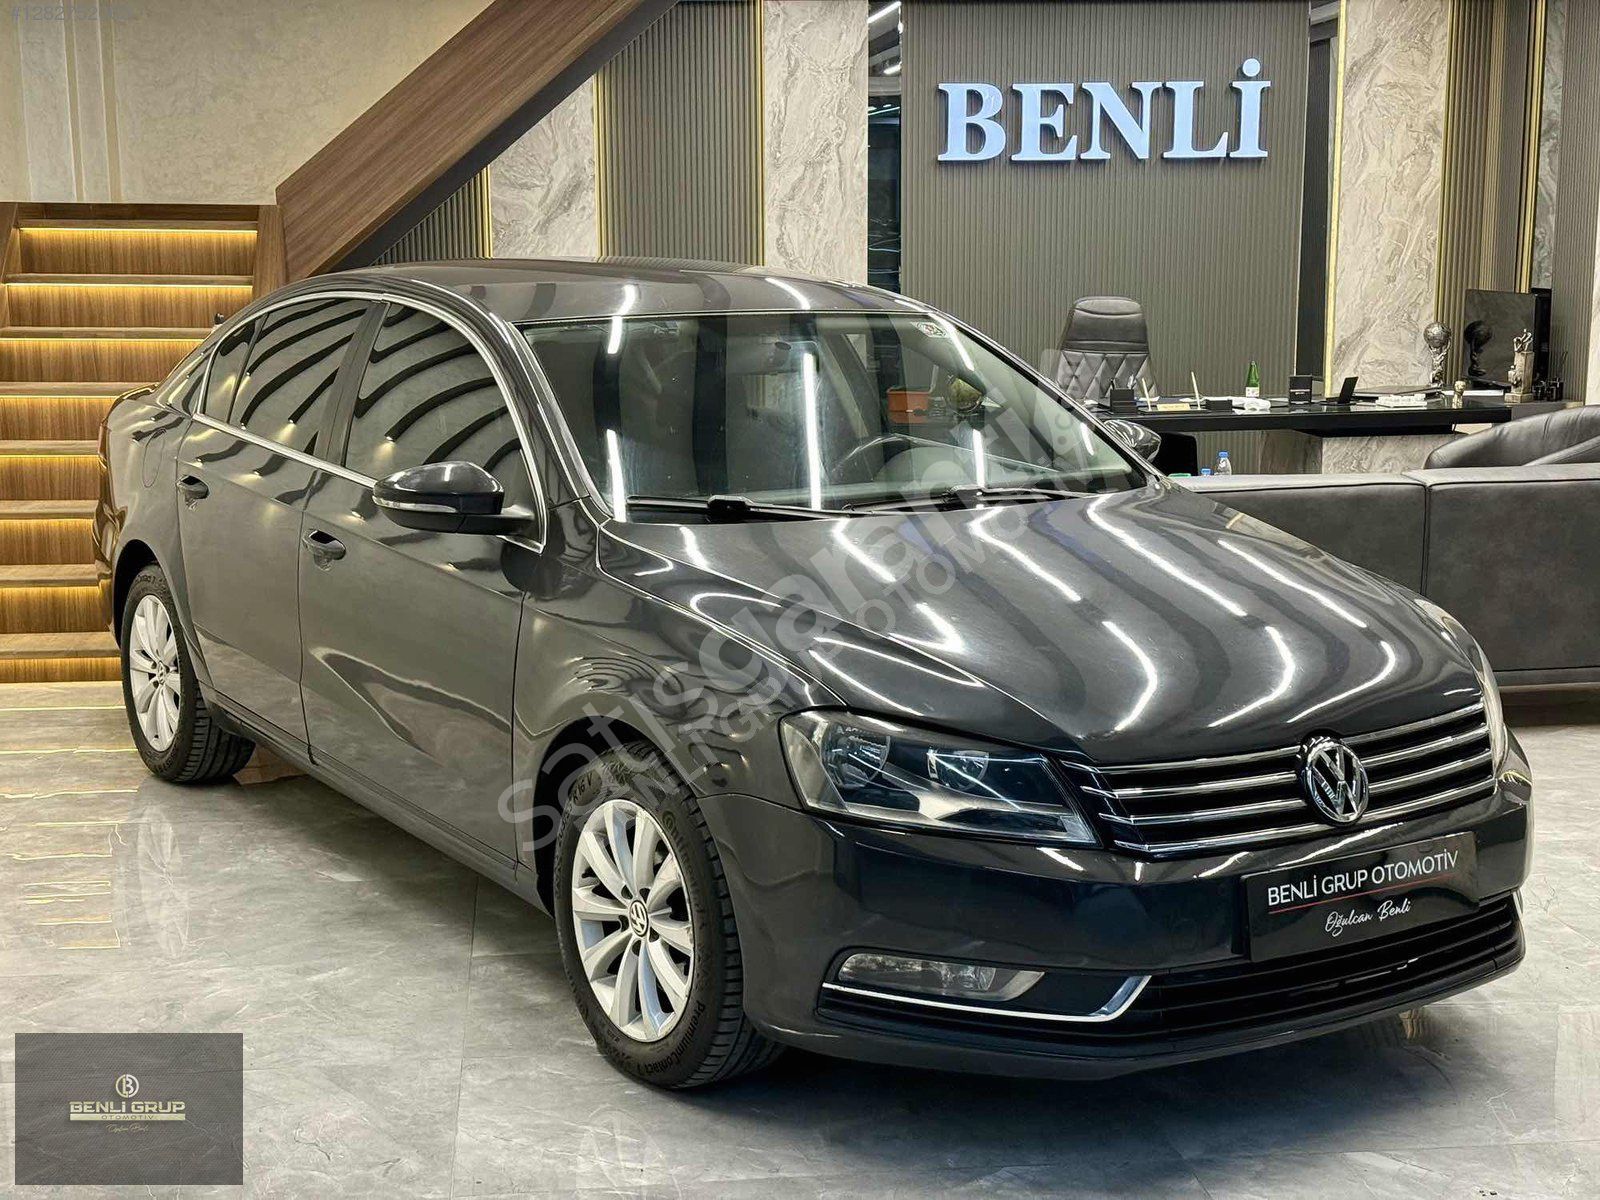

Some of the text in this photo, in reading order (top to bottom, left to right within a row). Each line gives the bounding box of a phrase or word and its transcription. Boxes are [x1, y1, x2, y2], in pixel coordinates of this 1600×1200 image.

[937, 57, 1271, 162] BENLİ
[1268, 848, 1459, 906] BENLİ GRUP OTOMOTİV
[1324, 897, 1412, 937] Oğulcan Benli
